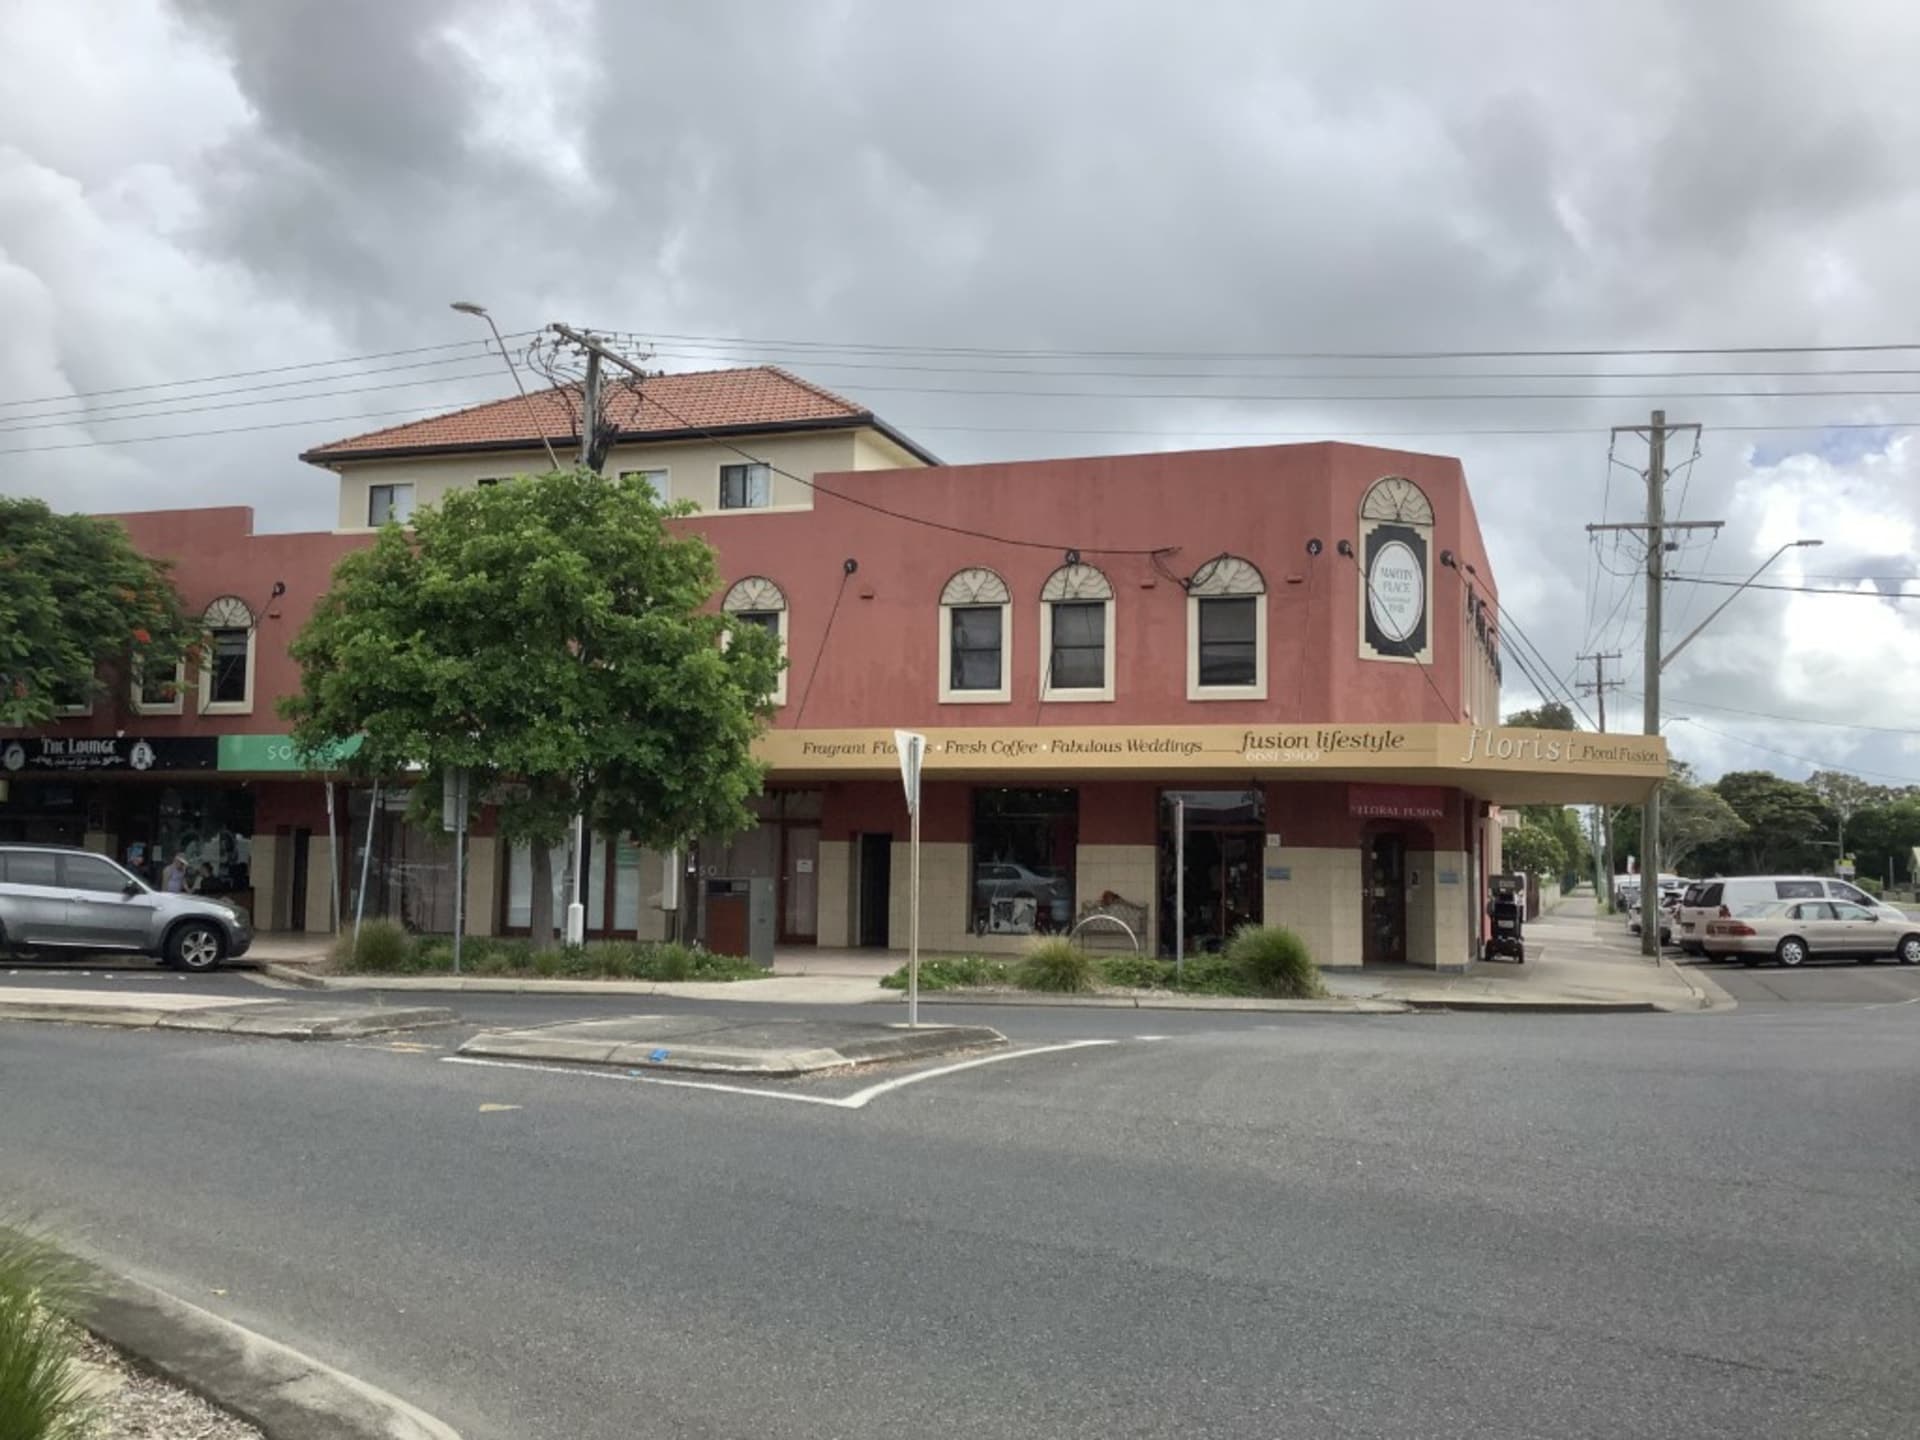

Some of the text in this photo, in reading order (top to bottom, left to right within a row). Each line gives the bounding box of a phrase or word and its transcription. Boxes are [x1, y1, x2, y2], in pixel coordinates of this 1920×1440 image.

[802, 737, 1203, 758] Fragrant Flos Fresh Coffee Fabulous Weddings
[1235, 729, 1405, 754] fusion lifestyle
[1461, 727, 1577, 764] florist
[1582, 745, 1660, 763] Floral Fusion
[1403, 807, 1444, 818] FUSION
